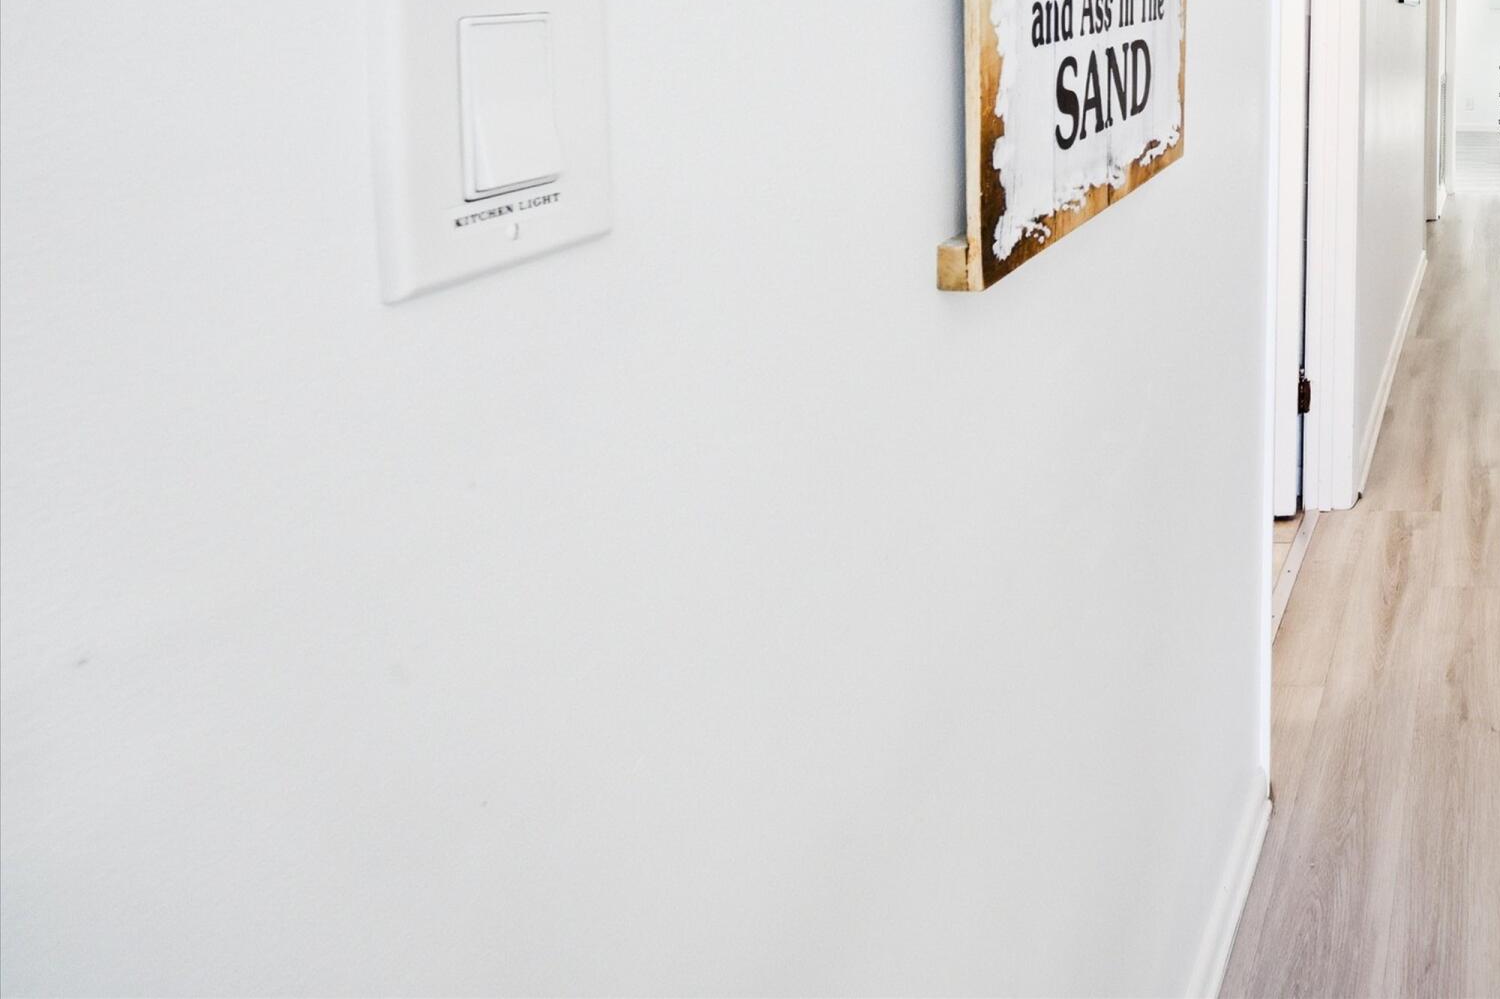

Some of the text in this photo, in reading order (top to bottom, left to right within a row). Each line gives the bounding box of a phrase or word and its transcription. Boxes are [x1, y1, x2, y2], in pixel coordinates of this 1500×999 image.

[1055, 39, 1151, 150] SAND
[455, 192, 560, 227] KITCHEN LIGHT
